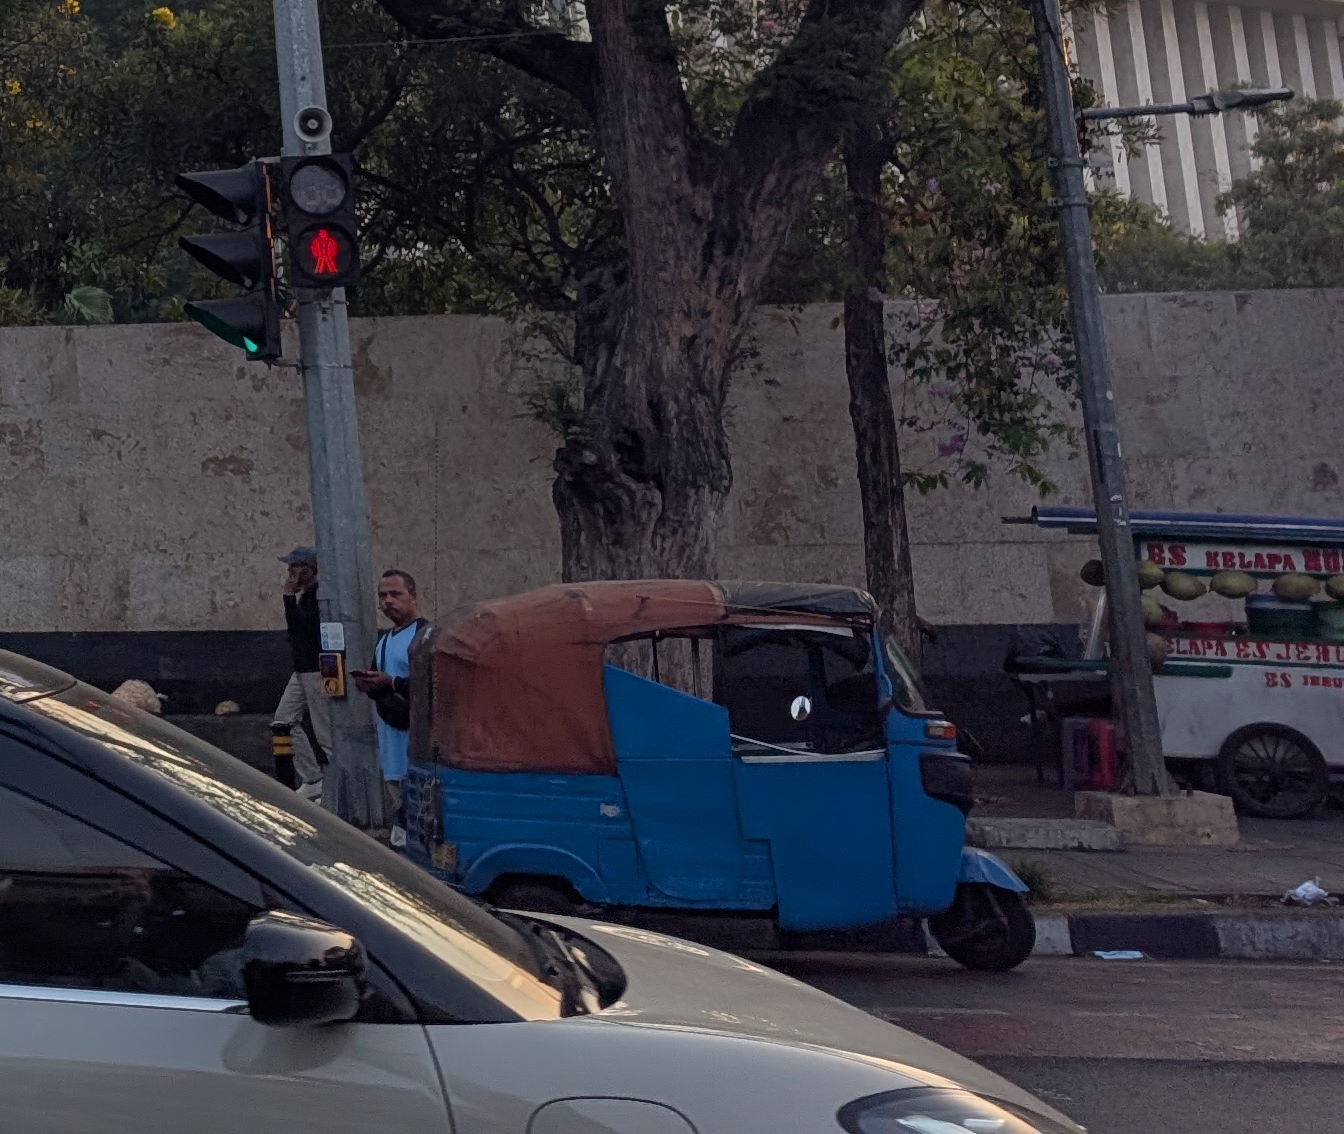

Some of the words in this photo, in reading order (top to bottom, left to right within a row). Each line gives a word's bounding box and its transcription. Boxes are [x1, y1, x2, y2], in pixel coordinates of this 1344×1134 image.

[1146, 542, 1187, 566] ES
[1205, 550, 1297, 571] KELAPA
[1302, 548, 1344, 573] MU
[1235, 640, 1271, 659] ES
[1265, 671, 1292, 688] ES
